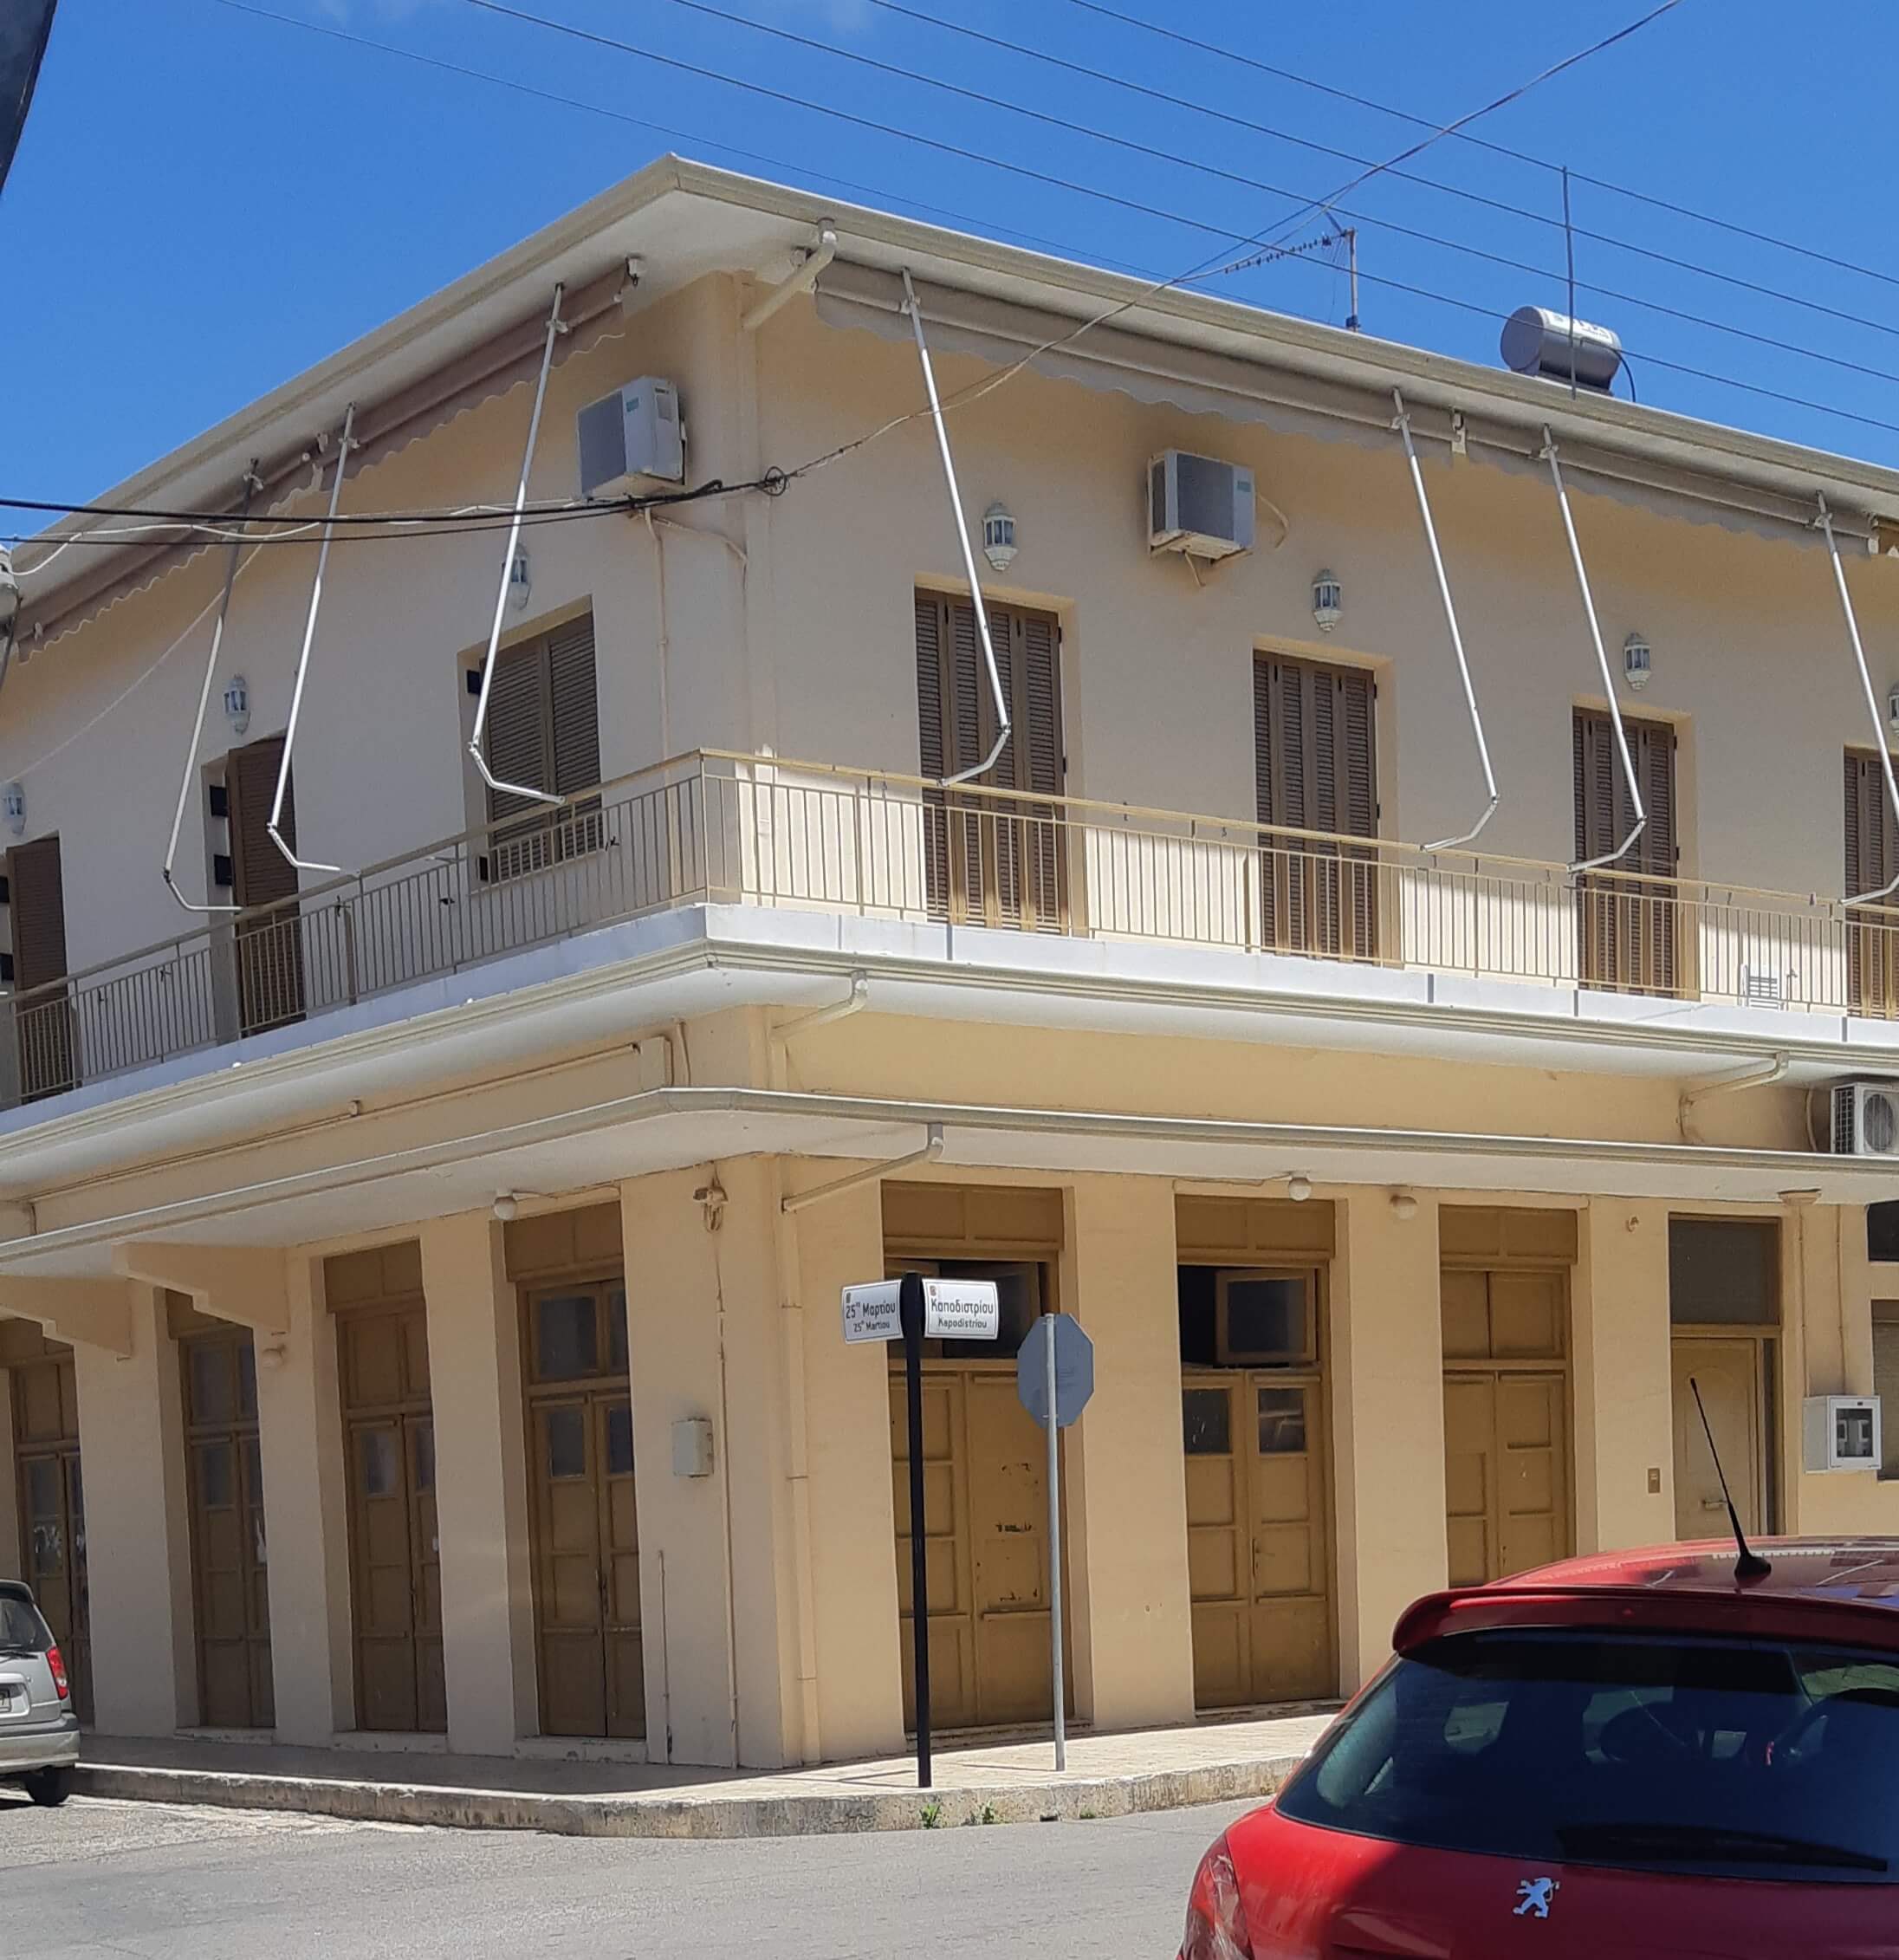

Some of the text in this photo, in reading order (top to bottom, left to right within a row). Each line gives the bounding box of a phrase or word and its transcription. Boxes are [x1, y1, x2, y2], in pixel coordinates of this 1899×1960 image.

[862, 1300, 896, 1319] Μαρτίου
[931, 1298, 994, 1317] Καποδιστρίου
[865, 1321, 890, 1331] Martiou
[938, 1317, 987, 1329] Kapodistriou
